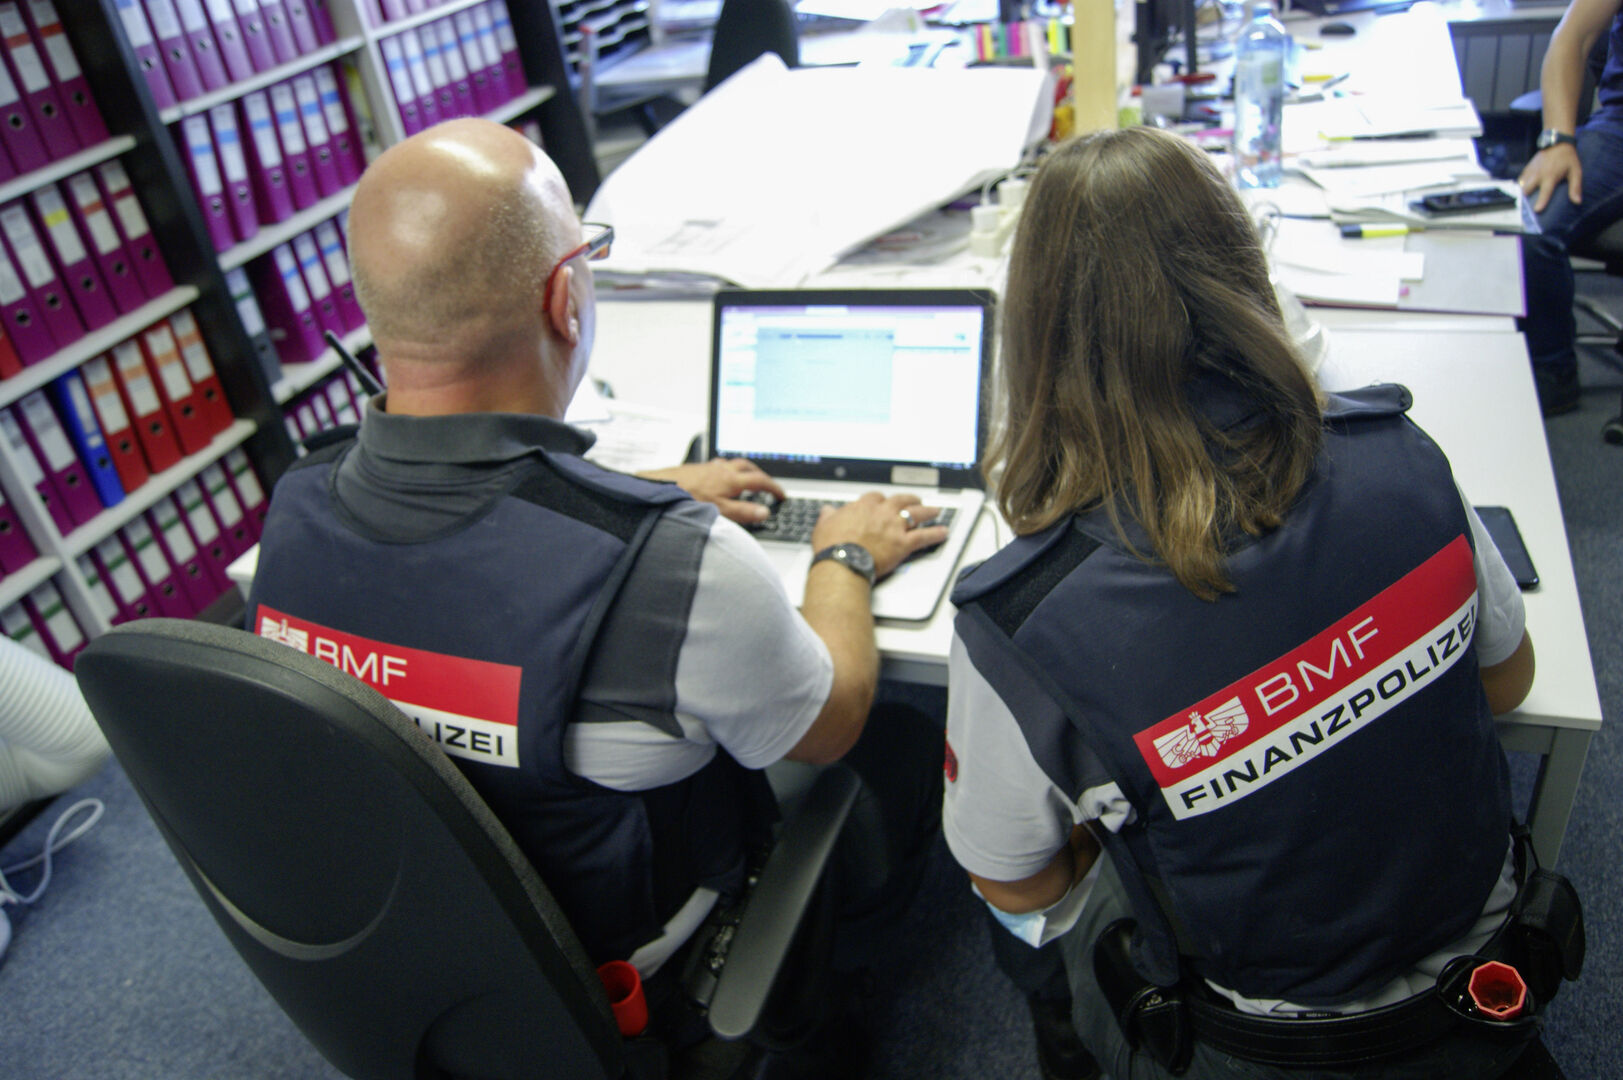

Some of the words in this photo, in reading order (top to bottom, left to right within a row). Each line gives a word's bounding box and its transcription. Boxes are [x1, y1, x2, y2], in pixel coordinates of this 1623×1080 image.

[315, 636, 408, 686] BMF
[1179, 604, 1475, 810] FINANZPOLIZEI
[1254, 615, 1379, 717] BMF
